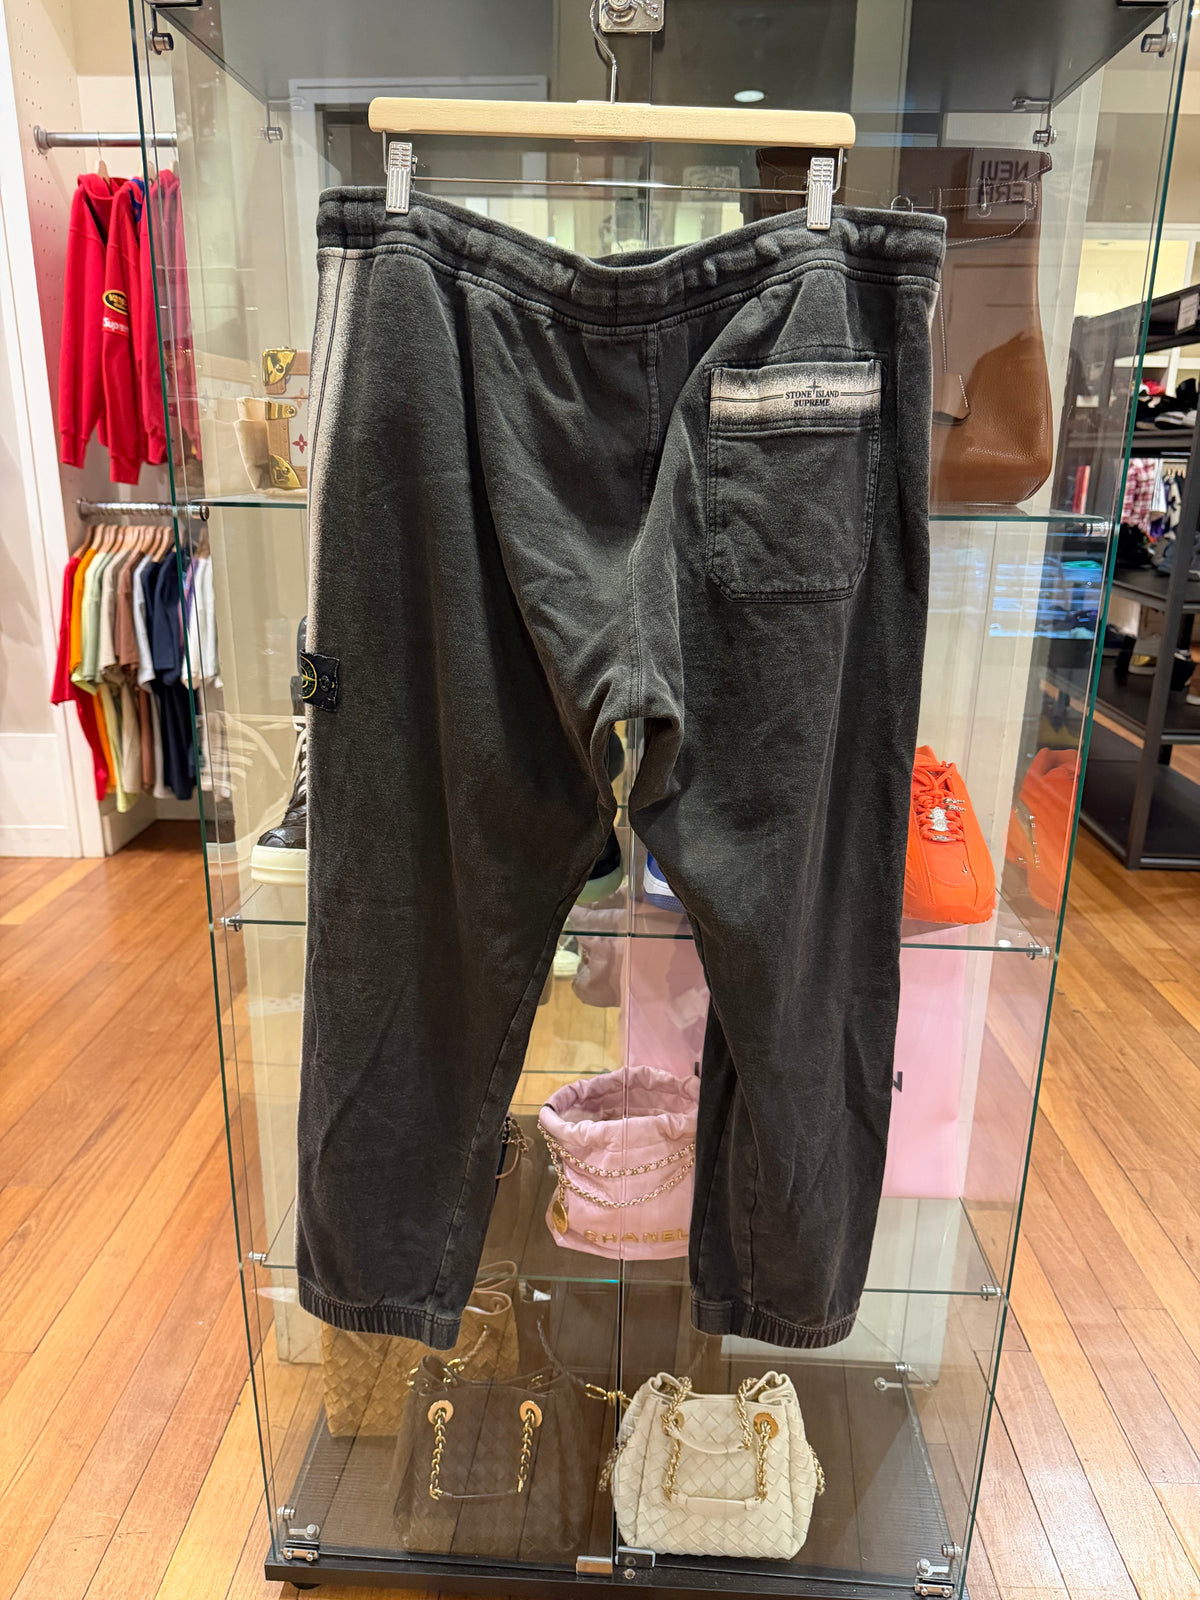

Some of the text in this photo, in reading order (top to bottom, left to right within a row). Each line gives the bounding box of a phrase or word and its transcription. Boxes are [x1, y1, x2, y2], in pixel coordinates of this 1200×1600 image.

[785, 390, 840, 400] STONE ISLAND
[794, 399, 830, 408] SUPREME
[583, 1228, 689, 1244] CHANEL
